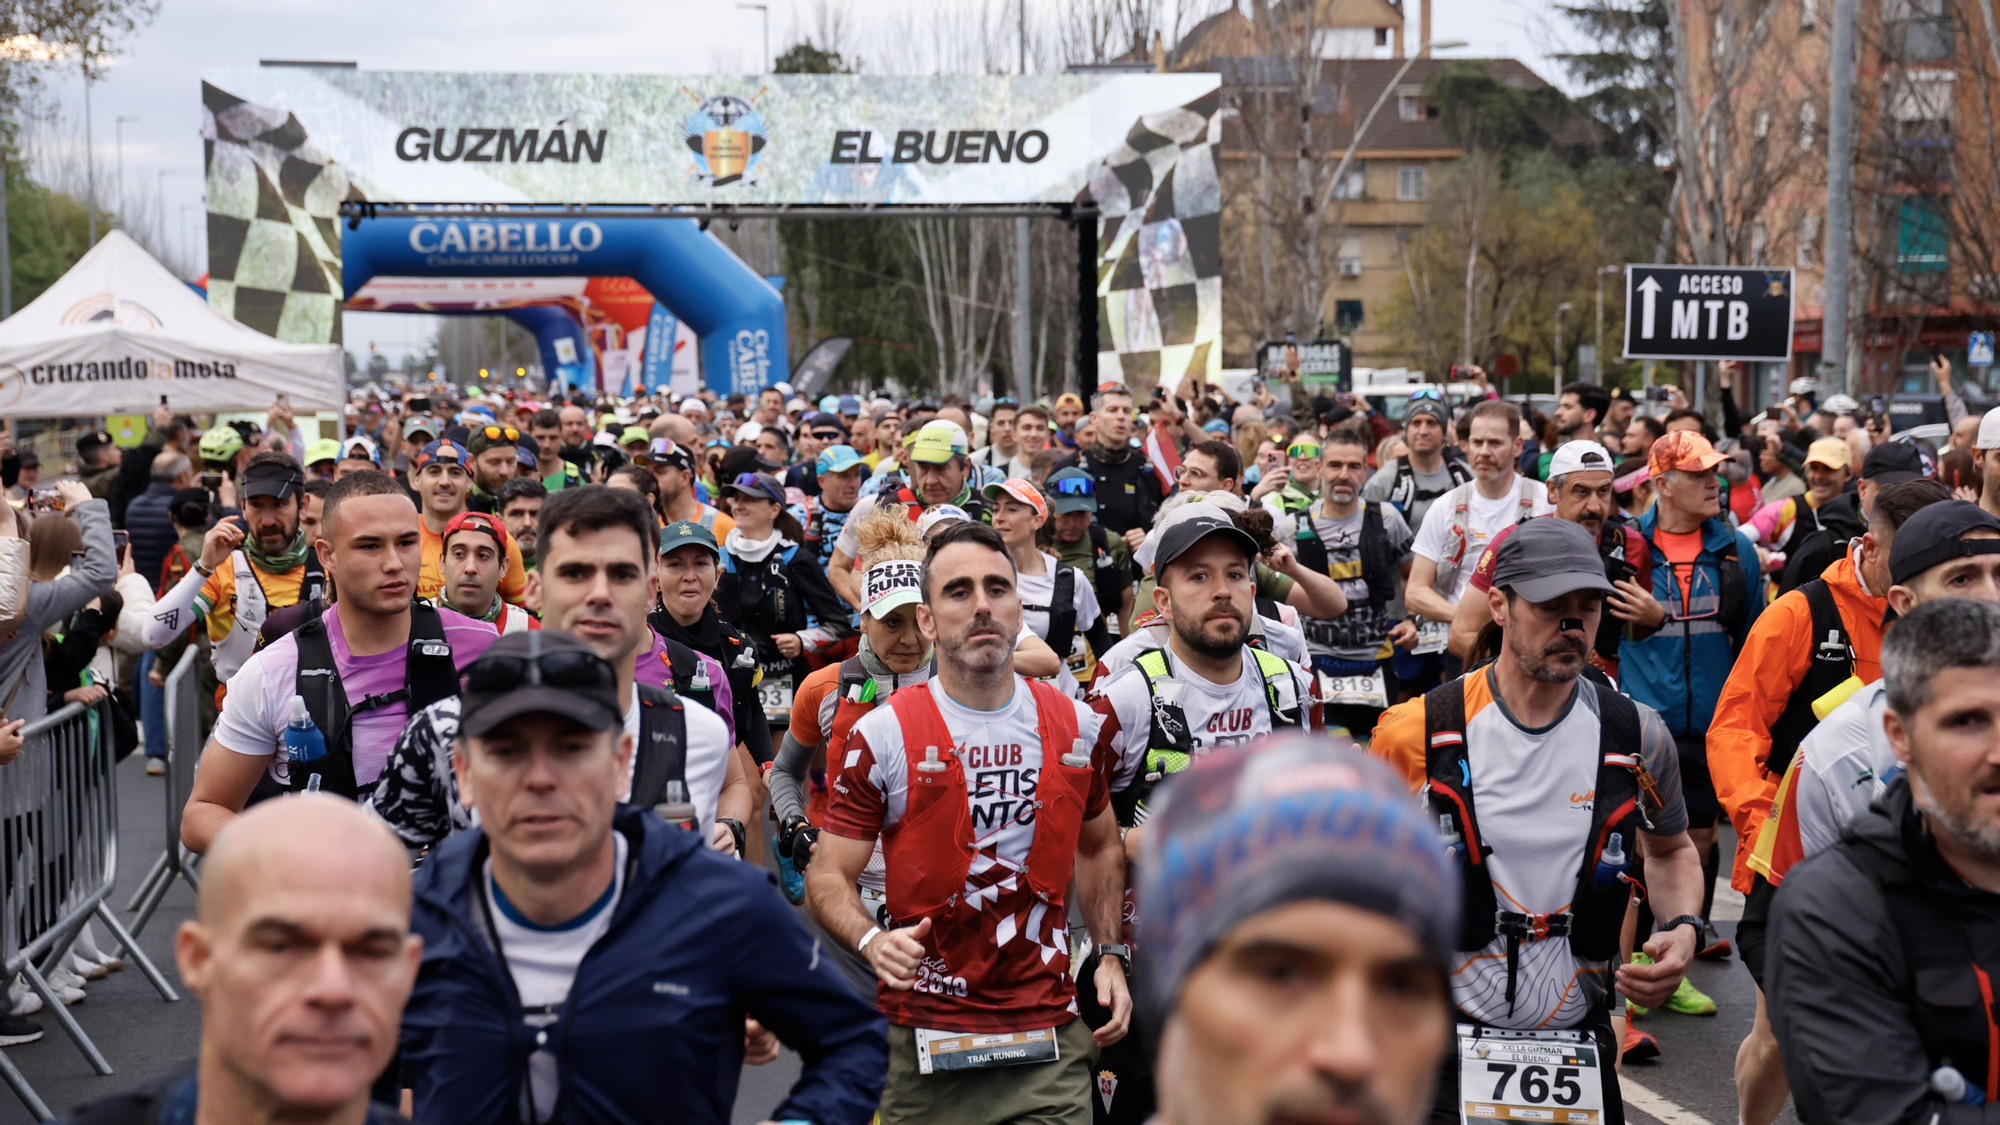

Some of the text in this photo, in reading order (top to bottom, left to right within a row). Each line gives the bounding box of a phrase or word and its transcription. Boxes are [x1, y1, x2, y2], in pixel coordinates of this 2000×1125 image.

[395, 118, 607, 164] GUZMÁN
[830, 129, 1049, 164] EL BUENO
[408, 220, 604, 254] CABELLO
[1678, 274, 1743, 295] ACCESO
[1671, 299, 1749, 341] MTB
[1331, 677, 1374, 693] 819
[1206, 707, 1253, 734] CLUB
[968, 743, 1023, 769] CLUB
[968, 767, 1042, 800] ETIS
[966, 1049, 1026, 1064] TRAIL RUNING
[1511, 1053, 1550, 1063] EL BUENO
[1486, 1062, 1581, 1106] 765
